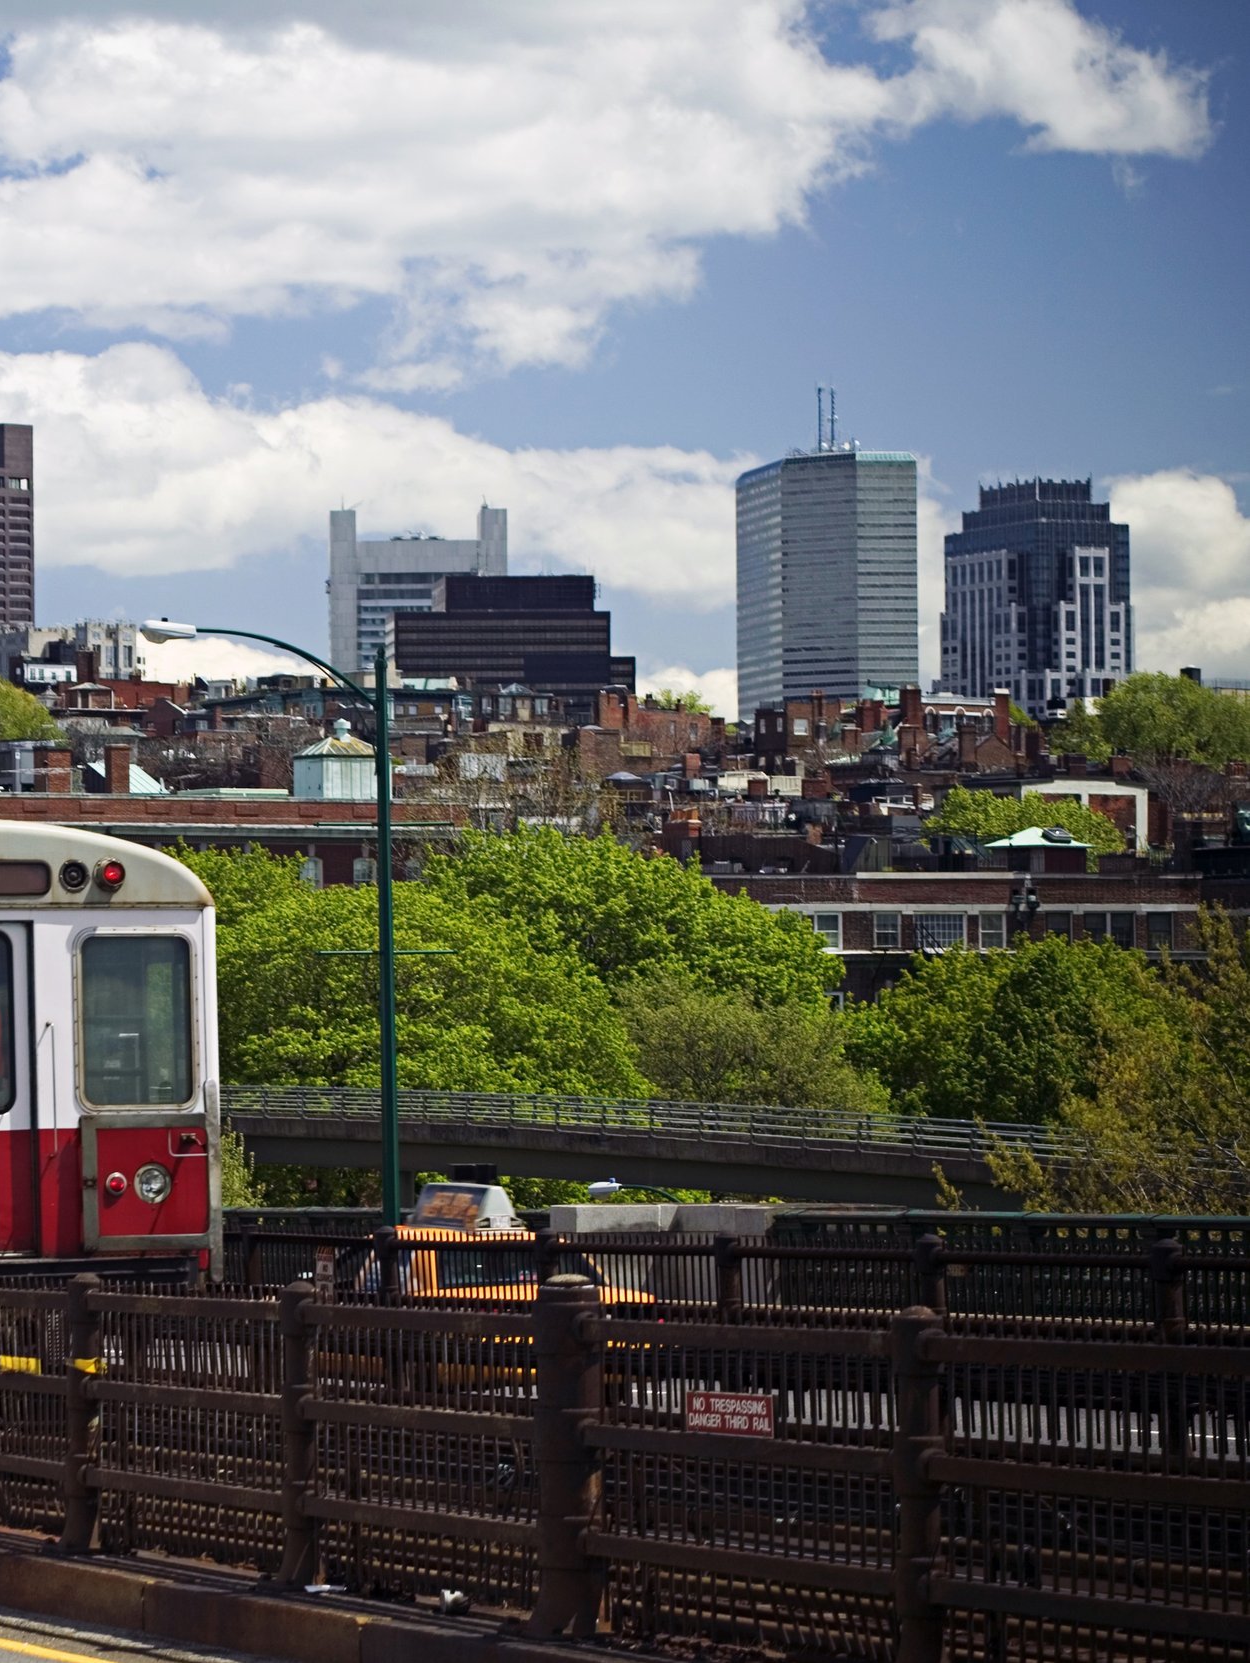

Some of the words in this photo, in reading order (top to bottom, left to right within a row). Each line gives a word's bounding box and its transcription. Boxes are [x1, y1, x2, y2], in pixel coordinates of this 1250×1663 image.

[693, 1397, 705, 1411] NO
[710, 1398, 766, 1415] TRESPASSING
[689, 1413, 721, 1428] DANGER
[725, 1415, 748, 1429] THIRD
[753, 1417, 771, 1431] RAIL
